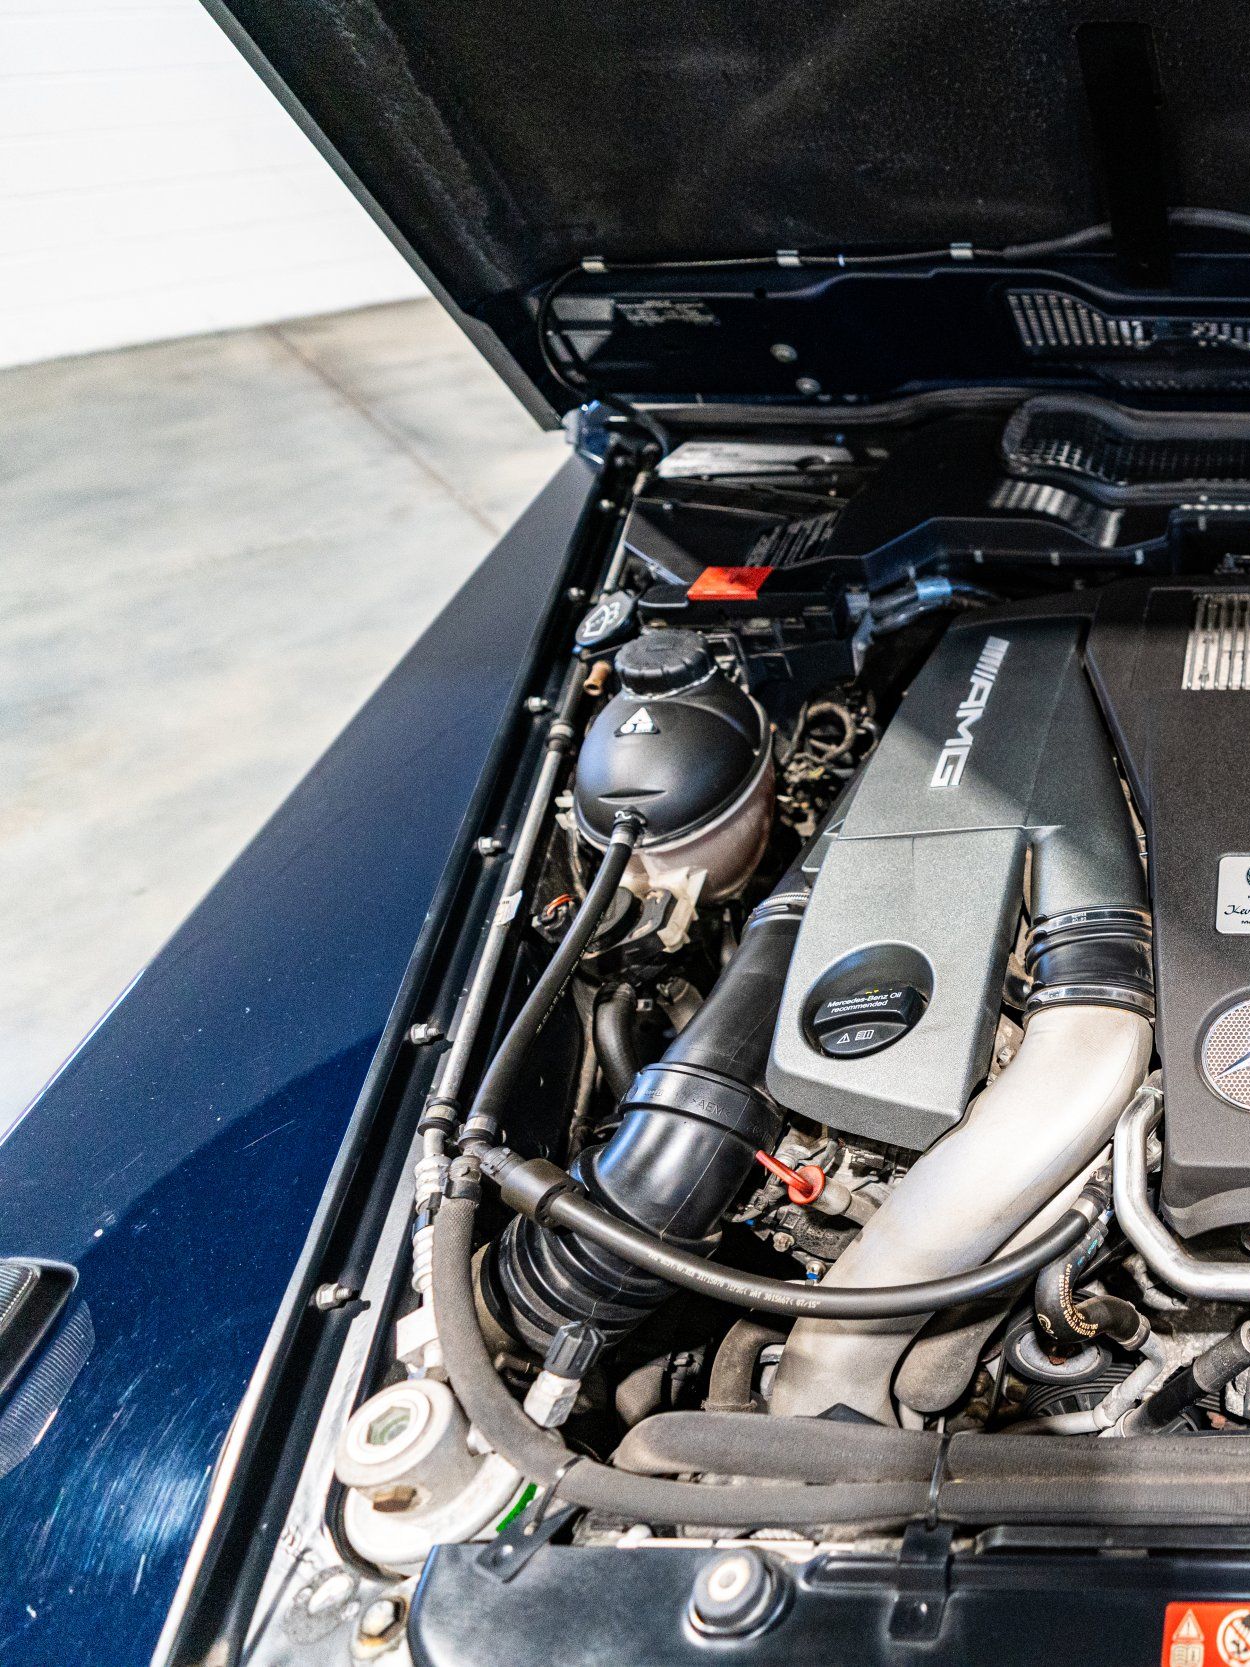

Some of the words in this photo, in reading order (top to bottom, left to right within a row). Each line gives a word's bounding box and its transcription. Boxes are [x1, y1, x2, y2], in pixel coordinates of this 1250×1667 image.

[827, 994, 889, 1008] Mercedes-Benz
[889, 991, 902, 999] Oil
[830, 1000, 889, 1014] recommended
